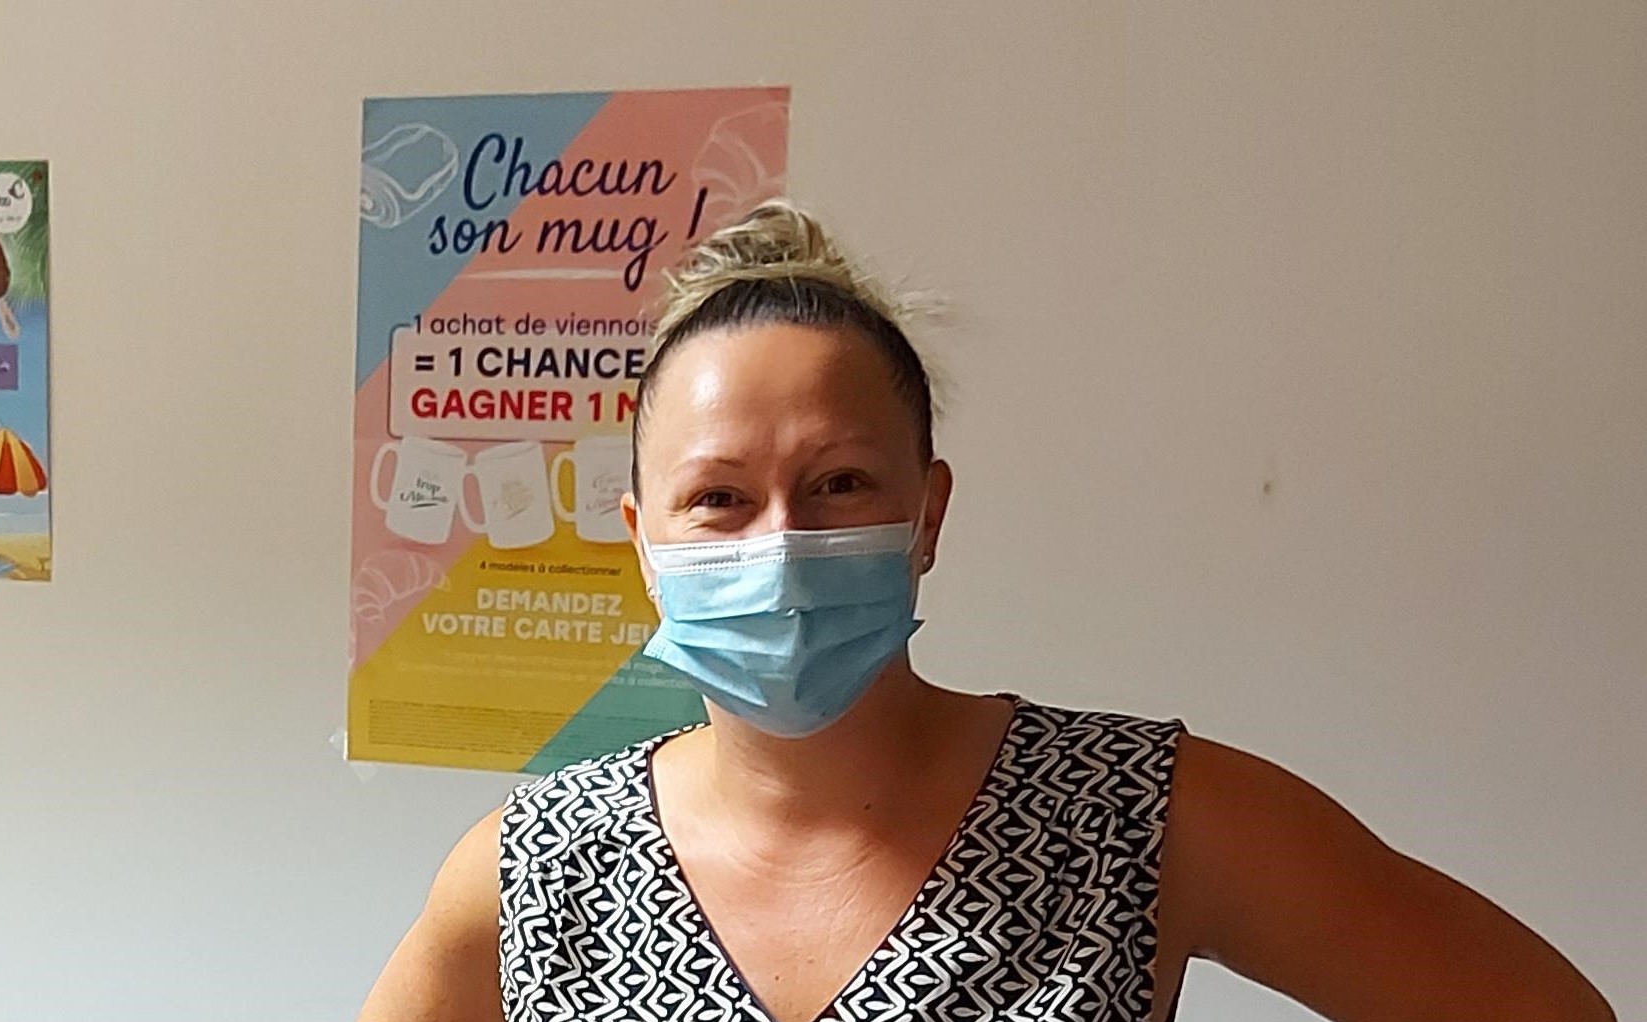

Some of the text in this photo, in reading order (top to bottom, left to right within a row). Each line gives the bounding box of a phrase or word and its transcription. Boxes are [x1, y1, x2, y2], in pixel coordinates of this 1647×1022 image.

[463, 132, 678, 211] Chacun
[428, 215, 523, 255] son
[535, 216, 669, 293] mug
[413, 314, 423, 335] 1
[430, 312, 505, 336] achat
[514, 313, 547, 336] de
[448, 346, 463, 377] 1
[476, 346, 646, 380] CHANCE
[410, 387, 574, 421] GAGNER
[586, 391, 602, 422] 1
[476, 587, 623, 617] DEMANDEZ
[422, 612, 507, 638] VOTRE
[513, 617, 603, 643] CARTE
